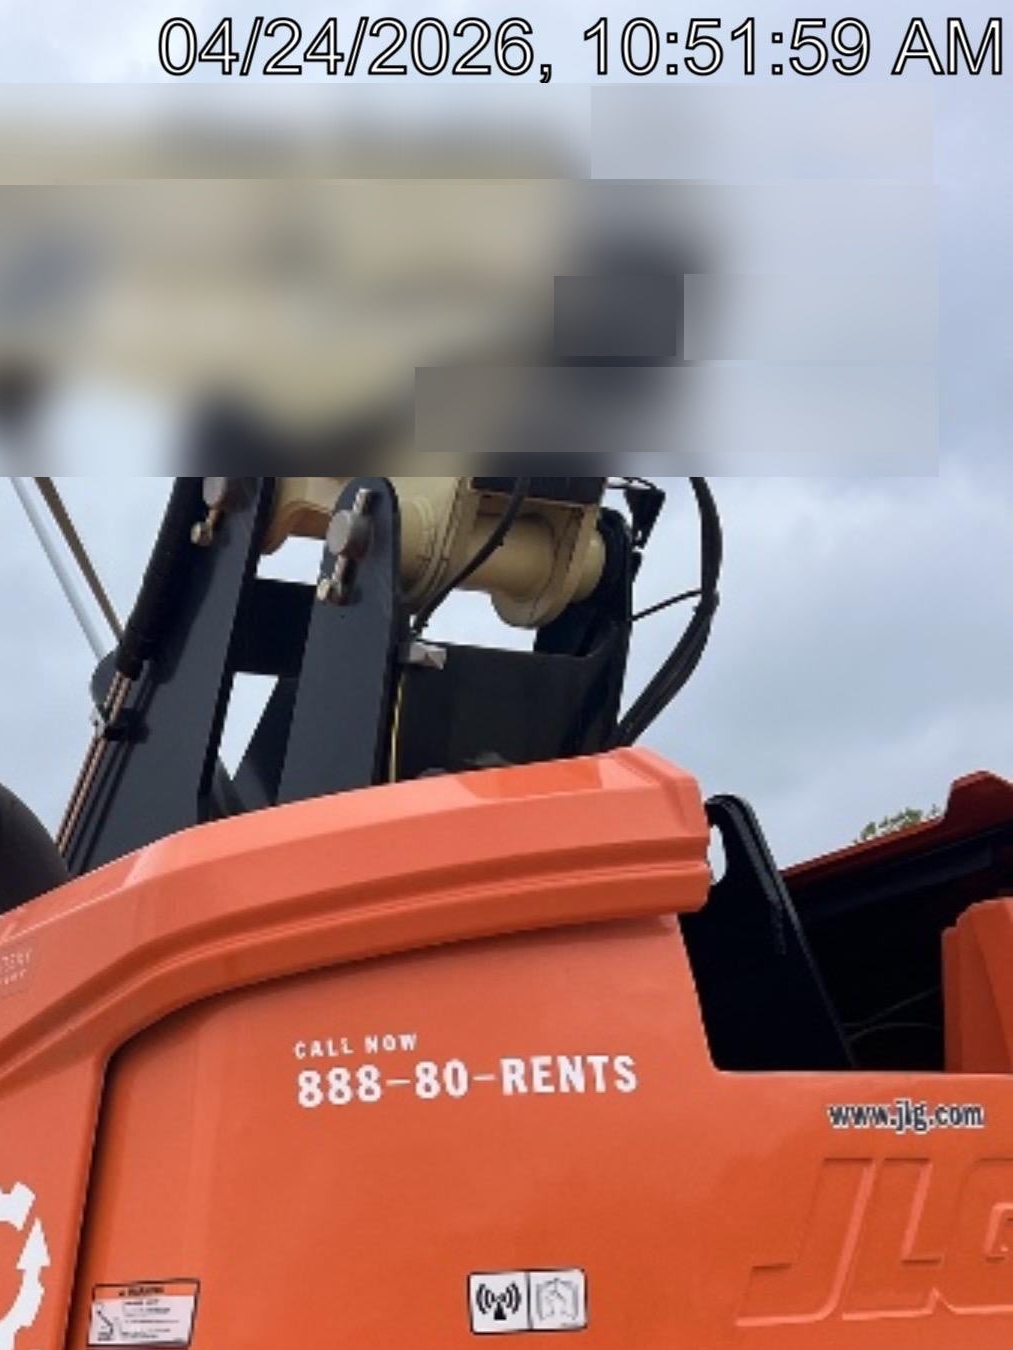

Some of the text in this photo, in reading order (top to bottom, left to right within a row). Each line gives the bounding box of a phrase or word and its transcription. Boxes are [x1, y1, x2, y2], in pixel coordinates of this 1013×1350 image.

[293, 1032, 418, 1060] CALL NOW
[297, 1055, 638, 1109] 888-80-RENTS
[826, 1097, 985, 1135] www.jlg.com
